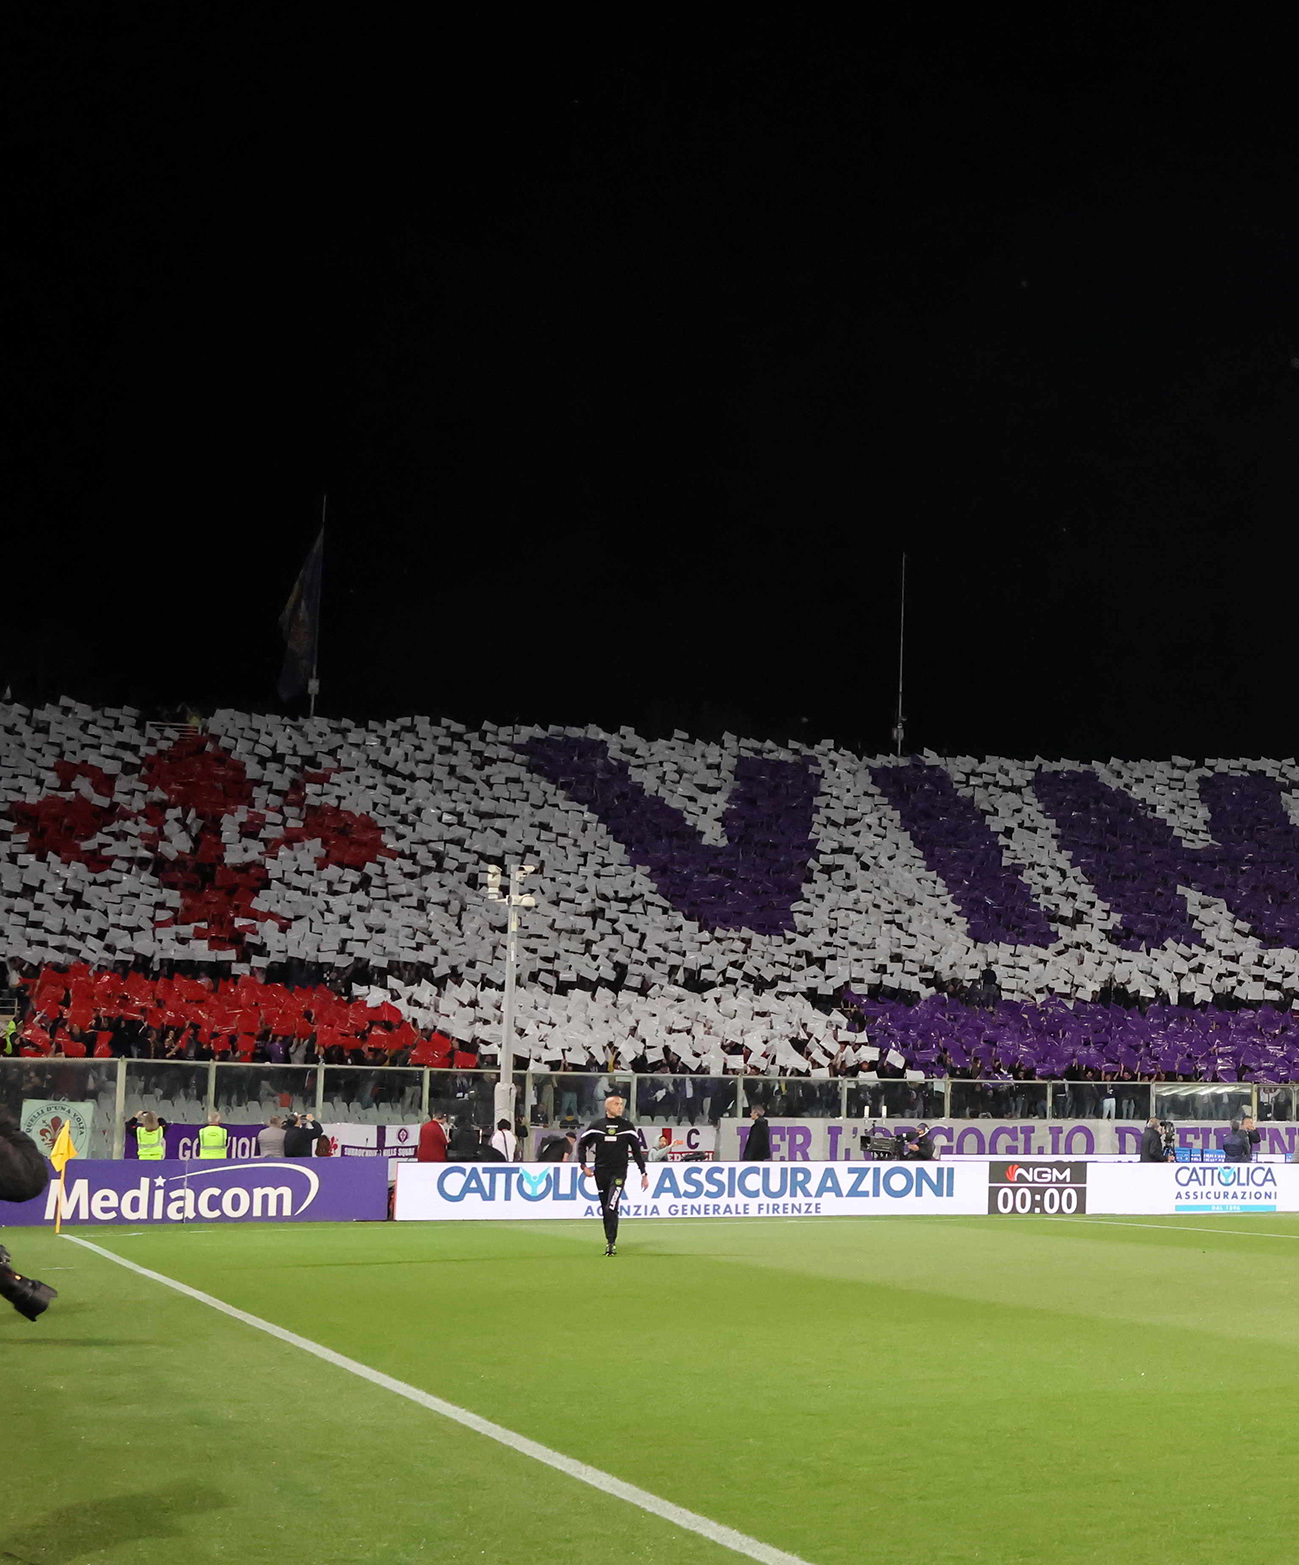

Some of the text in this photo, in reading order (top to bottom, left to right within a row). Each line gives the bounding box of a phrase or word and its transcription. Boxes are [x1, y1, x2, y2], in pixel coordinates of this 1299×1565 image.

[26, 1105, 84, 1136] QUELLI D'UNA VOLTA
[437, 1166, 954, 1202] CATTOLIC ASSICURAZIONI
[1014, 1167, 1071, 1182] NGM
[1174, 1166, 1278, 1187] CATTOLICA
[44, 1175, 293, 1220] Mediacom
[997, 1187, 1078, 1214] 00:00
[1175, 1191, 1278, 1200] ASSICURAZIONI
[584, 1202, 822, 1217] AGNZIA GENERALE FIRENZE
